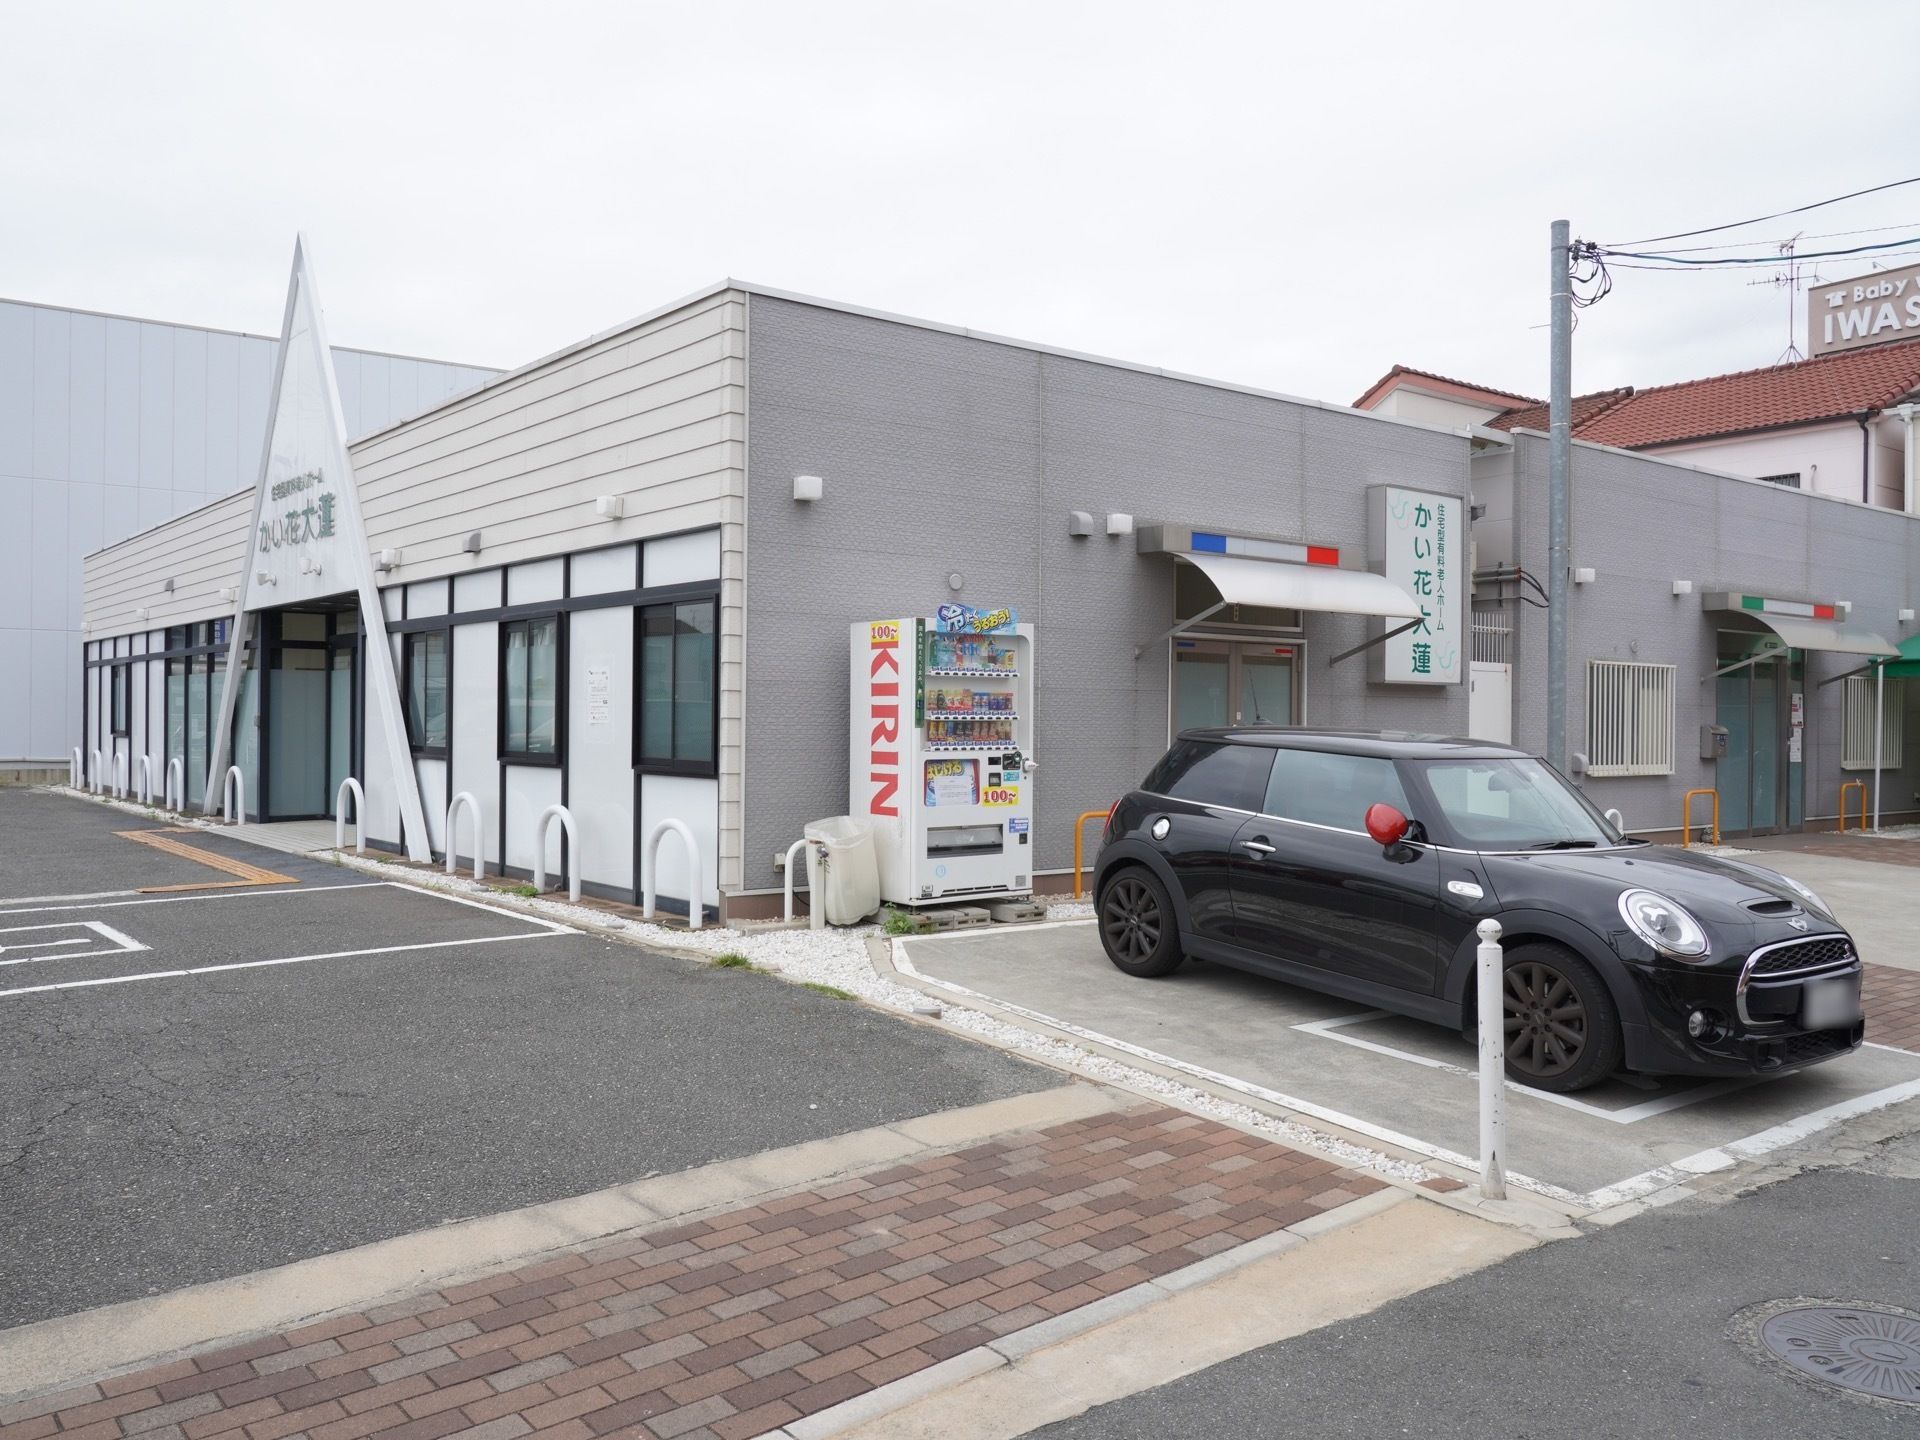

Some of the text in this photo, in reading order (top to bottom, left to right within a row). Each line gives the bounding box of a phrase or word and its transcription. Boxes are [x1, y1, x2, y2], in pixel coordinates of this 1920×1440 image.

[1853, 279, 1909, 303] Baby
[1824, 295, 1920, 345] IWAS
[259, 491, 336, 553] かい花大蓮
[870, 641, 899, 817] KIRIN
